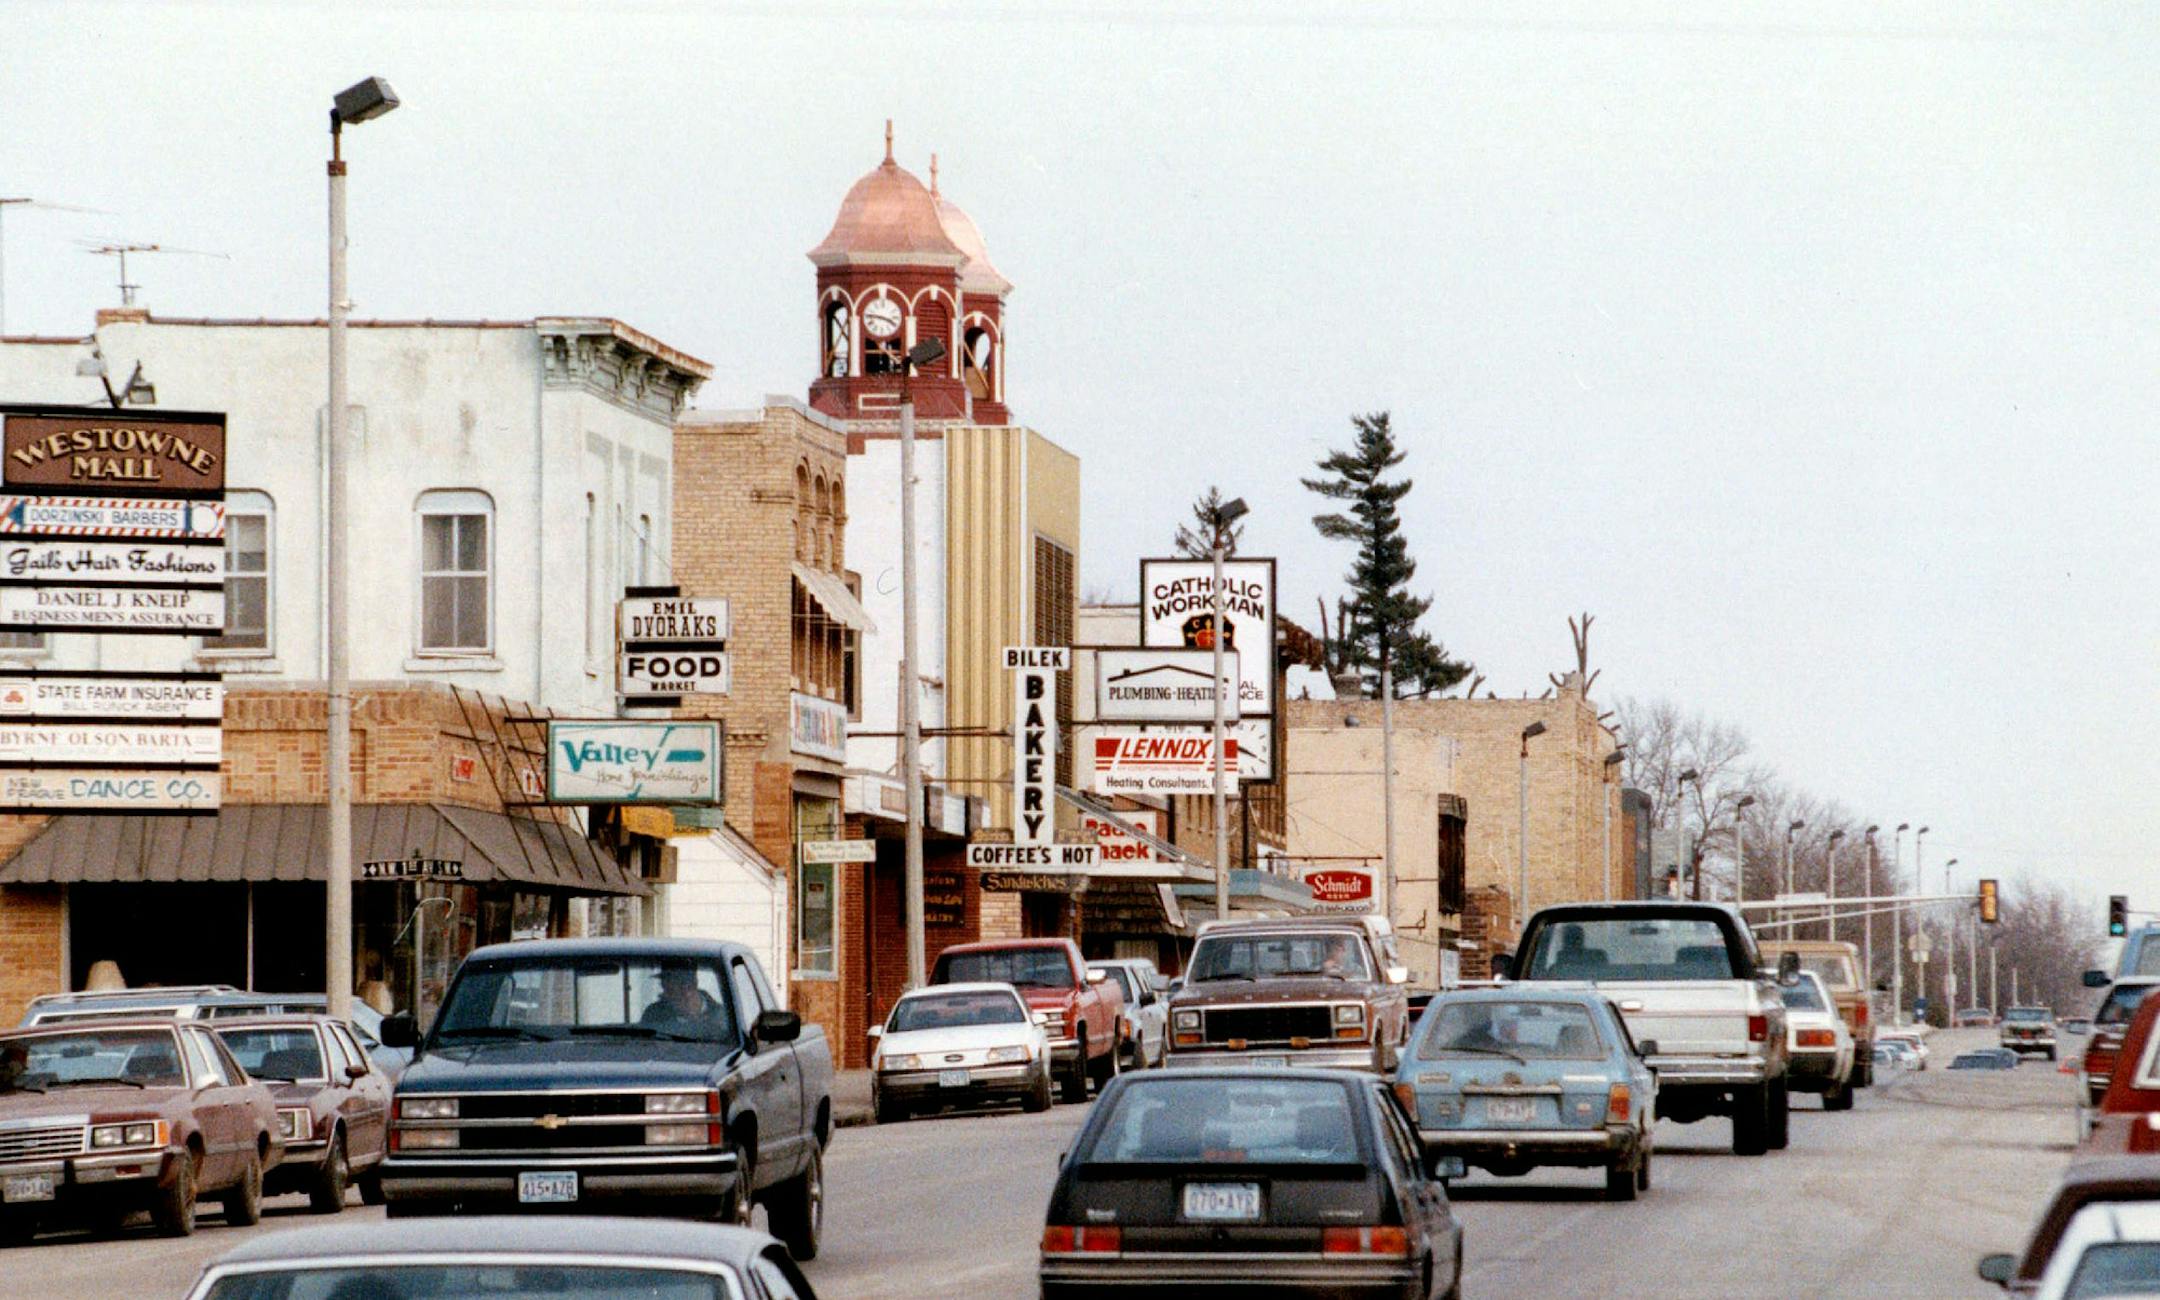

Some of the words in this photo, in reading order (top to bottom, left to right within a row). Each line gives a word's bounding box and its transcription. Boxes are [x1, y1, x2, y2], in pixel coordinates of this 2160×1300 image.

[11, 428, 217, 476] WESTOWNE
[71, 456, 161, 481] MALL
[30, 508, 104, 524] DORZINSKI
[112, 510, 178, 527] BARBERS
[8, 548, 62, 575] Gail's
[67, 549, 120, 572] Hair
[128, 550, 217, 574] Fashions
[38, 592, 107, 607] DANIEL
[132, 593, 191, 609] KNEIP
[652, 602, 697, 615] EMIL
[12, 610, 77, 622] BUSINESS
[129, 612, 215, 625] ASSURANCE
[632, 615, 717, 638] DVORAKS
[627, 657, 721, 678] FOOD
[1007, 650, 1063, 667] BILEK
[37, 684, 81, 699] STATE
[87, 685, 127, 700] FARM
[131, 686, 213, 701] INSURANCE
[650, 681, 696, 692] MARKET
[68, 733, 130, 746] OLSON
[1120, 738, 1213, 759] LENNOX
[558, 739, 662, 772] Valley
[1023, 674, 1046, 840] BAKERY
[70, 779, 157, 799] DANCE
[166, 780, 211, 799] CO.
[1106, 776, 1144, 790] Heating
[972, 846, 1052, 864] COFFEE'S
[1062, 847, 1094, 864] HOT
[1097, 841, 1149, 860] hack
[1313, 874, 1362, 896] Schmidt
